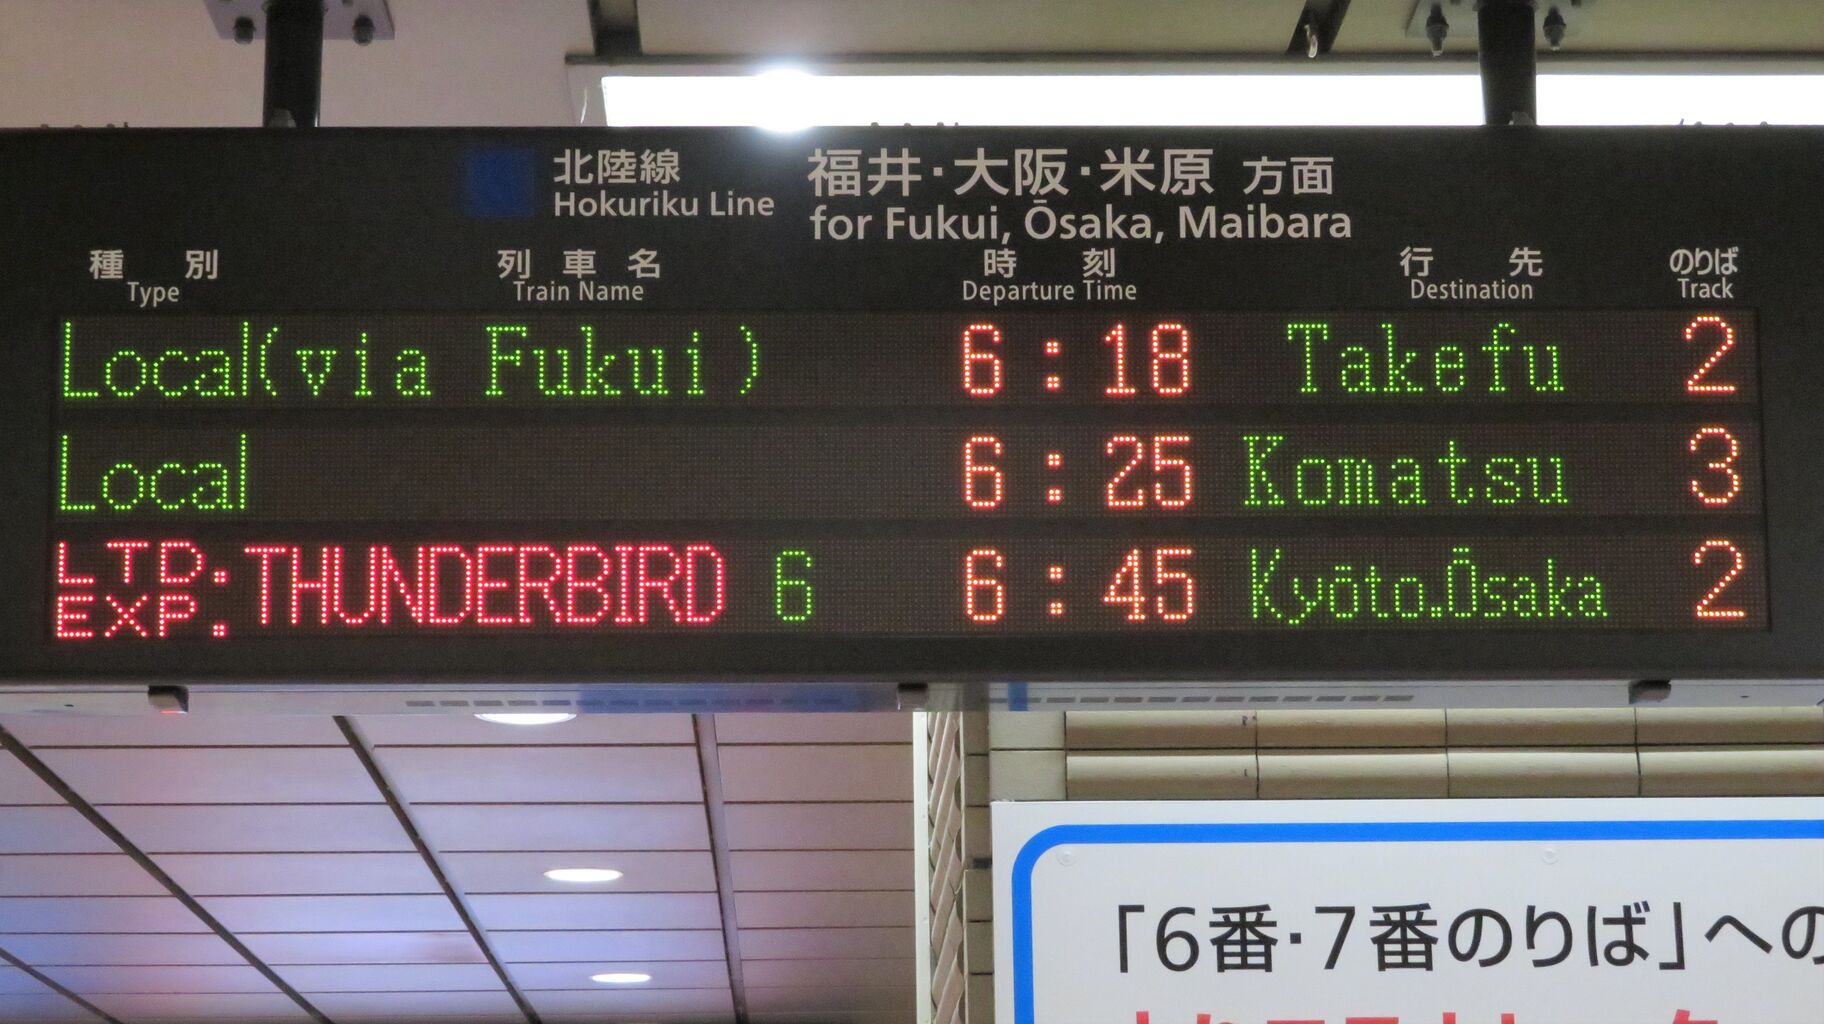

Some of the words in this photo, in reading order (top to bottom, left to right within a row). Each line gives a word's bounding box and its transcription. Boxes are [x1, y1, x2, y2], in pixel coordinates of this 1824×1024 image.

[554, 149, 680, 184] 北陸線
[1243, 156, 1333, 194] 方面
[555, 190, 698, 216] Hokuriku
[711, 191, 774, 216] Line
[810, 205, 872, 240] for
[887, 205, 1010, 244] Fukui,
[1025, 200, 1163, 243] Ōsaka,
[1180, 203, 1350, 238] Maibara
[1670, 247, 1738, 275] のりば
[127, 282, 180, 308] Type
[514, 281, 569, 300] Train
[580, 281, 643, 300] Name
[964, 281, 1074, 305] Departure
[1083, 280, 1136, 299] Time
[1412, 279, 1532, 299] Destination
[1678, 277, 1733, 298] Track
[1288, 323, 1564, 392] Takefu
[1684, 315, 1735, 393] 2
[61, 434, 246, 510] Local
[1243, 436, 1567, 505] Komatsu
[1689, 427, 1741, 506] 3
[244, 543, 726, 625] THUNDERBIRD
[777, 551, 811, 620] 6
[1693, 539, 1745, 620] 2
